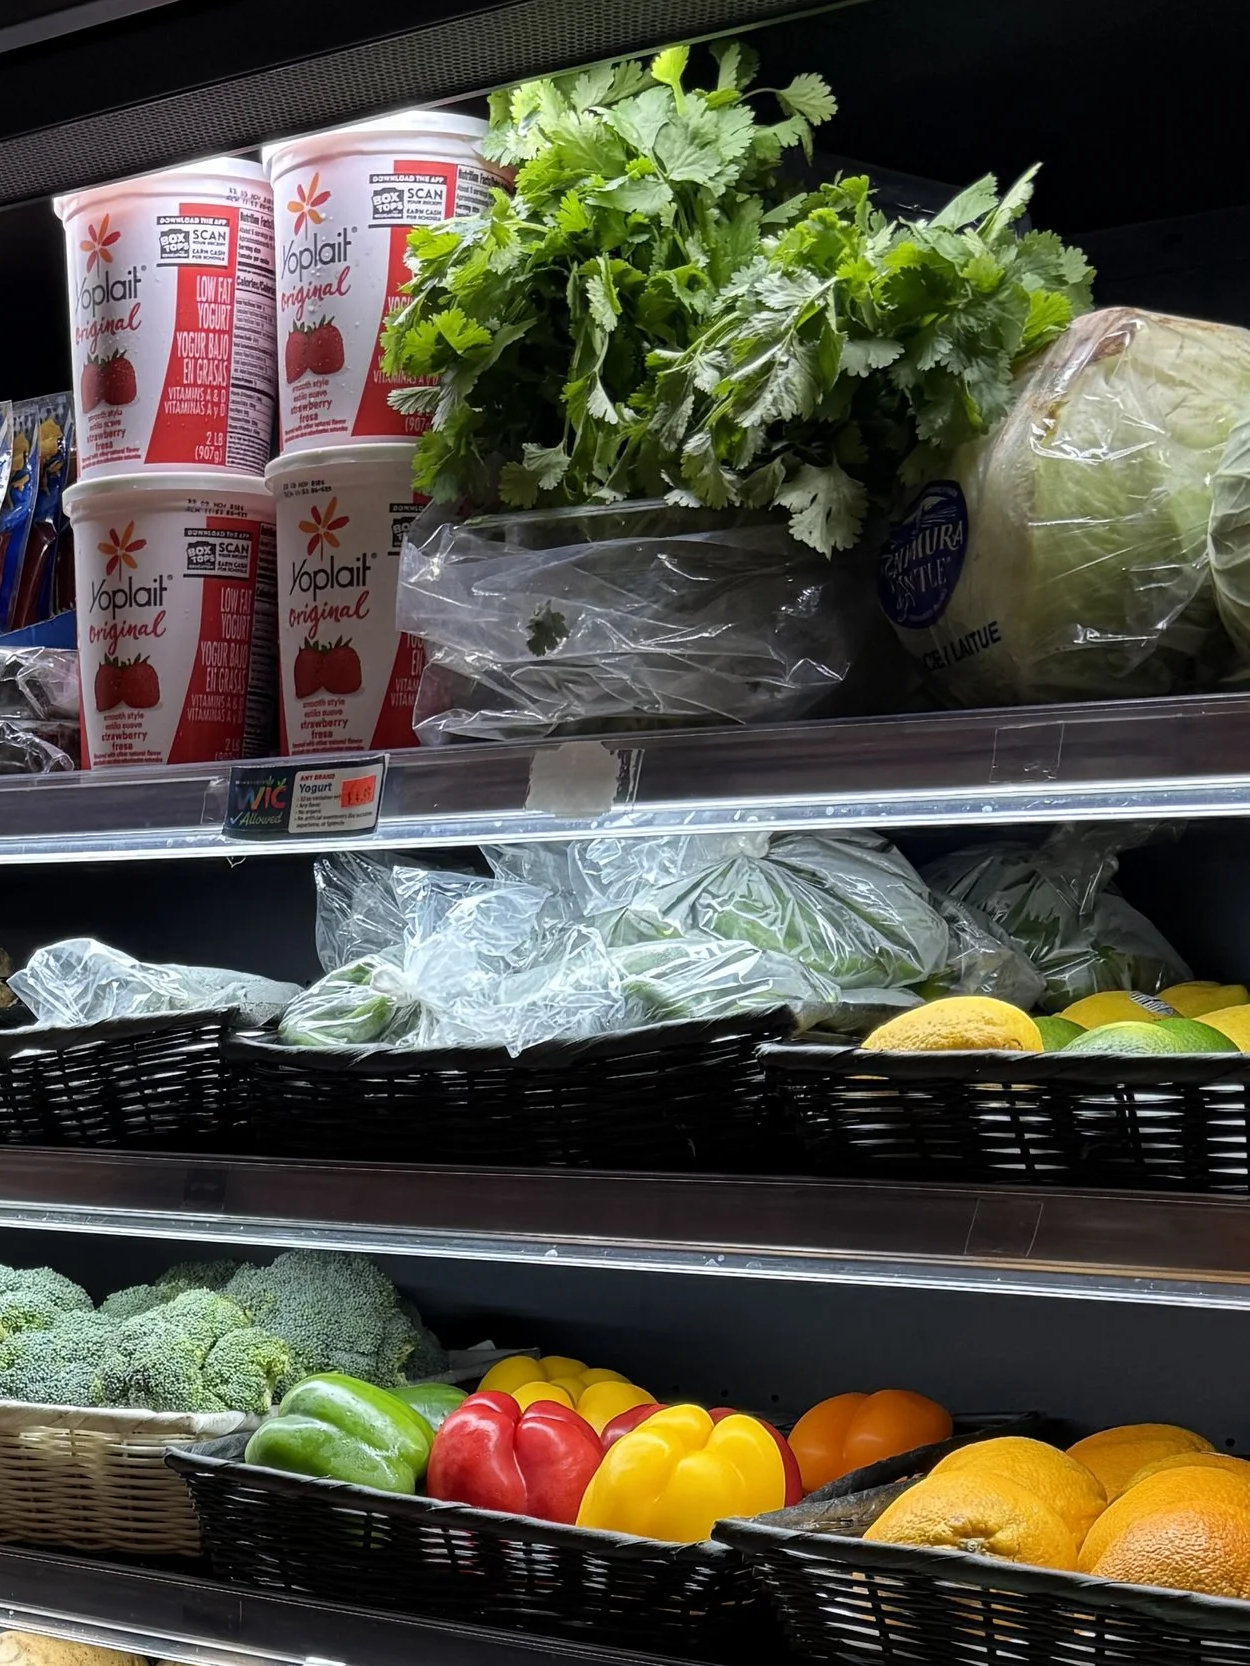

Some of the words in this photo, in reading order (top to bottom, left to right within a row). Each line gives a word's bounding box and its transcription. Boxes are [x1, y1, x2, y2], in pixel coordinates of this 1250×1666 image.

[372, 174, 415, 183] DOWNLOAD
[416, 175, 428, 183] THE
[373, 192, 400, 206] BOX
[407, 188, 443, 199] SCAN
[376, 203, 404, 213] TOPS
[160, 217, 199, 225] DOWNLOAD
[160, 233, 186, 244] BOX
[193, 229, 227, 241] SCAN
[165, 243, 189, 252] TOPS
[281, 227, 352, 282] Yoplait
[75, 265, 141, 318] Yoplait
[196, 275, 215, 301] LOW
[218, 276, 233, 304] FAT
[281, 265, 352, 321] original
[198, 303, 231, 330] YOGURT
[75, 302, 142, 353] original
[176, 331, 206, 358] YOGUR
[208, 334, 228, 359] BAJO
[184, 360, 194, 384] EN
[196, 361, 228, 386] GRASAS
[168, 387, 204, 402] VITAMINS
[205, 389, 212, 401] A
[165, 401, 205, 415] VITAMINAS
[206, 402, 212, 416] A
[220, 403, 226, 416] D
[290, 399, 333, 415] strawberry
[405, 416, 432, 433] (907
[86, 428, 126, 444] strawberry
[206, 431, 212, 445] 2
[214, 432, 223, 445] LB
[195, 445, 223, 463] (907g)
[187, 529, 225, 537] DOWNLOAD
[393, 522, 410, 534] BO
[188, 546, 212, 557] BOX
[218, 543, 249, 554] SCAN
[191, 555, 215, 563] TOPS
[289, 553, 371, 602] Yoplait
[90, 574, 167, 620] Yoplait
[221, 588, 237, 612] LOW
[289, 590, 370, 640] original
[89, 609, 166, 655] original
[222, 613, 251, 640] YOGURT
[954, 620, 1002, 662] LAITUE
[201, 641, 228, 666] YOGUR
[230, 643, 248, 668] BAJO
[206, 668, 217, 692] EN
[219, 669, 246, 694] GRASAS
[396, 679, 419, 691] VITAM
[391, 693, 416, 706] VITAM
[300, 718, 348, 729] strawberry
[102, 731, 148, 742] strawberry
[311, 730, 333, 739] fresa
[112, 742, 133, 751] fresa
[300, 783, 332, 794] Yogurt
[235, 784, 287, 811] WIC
[239, 811, 282, 826] Allowed
